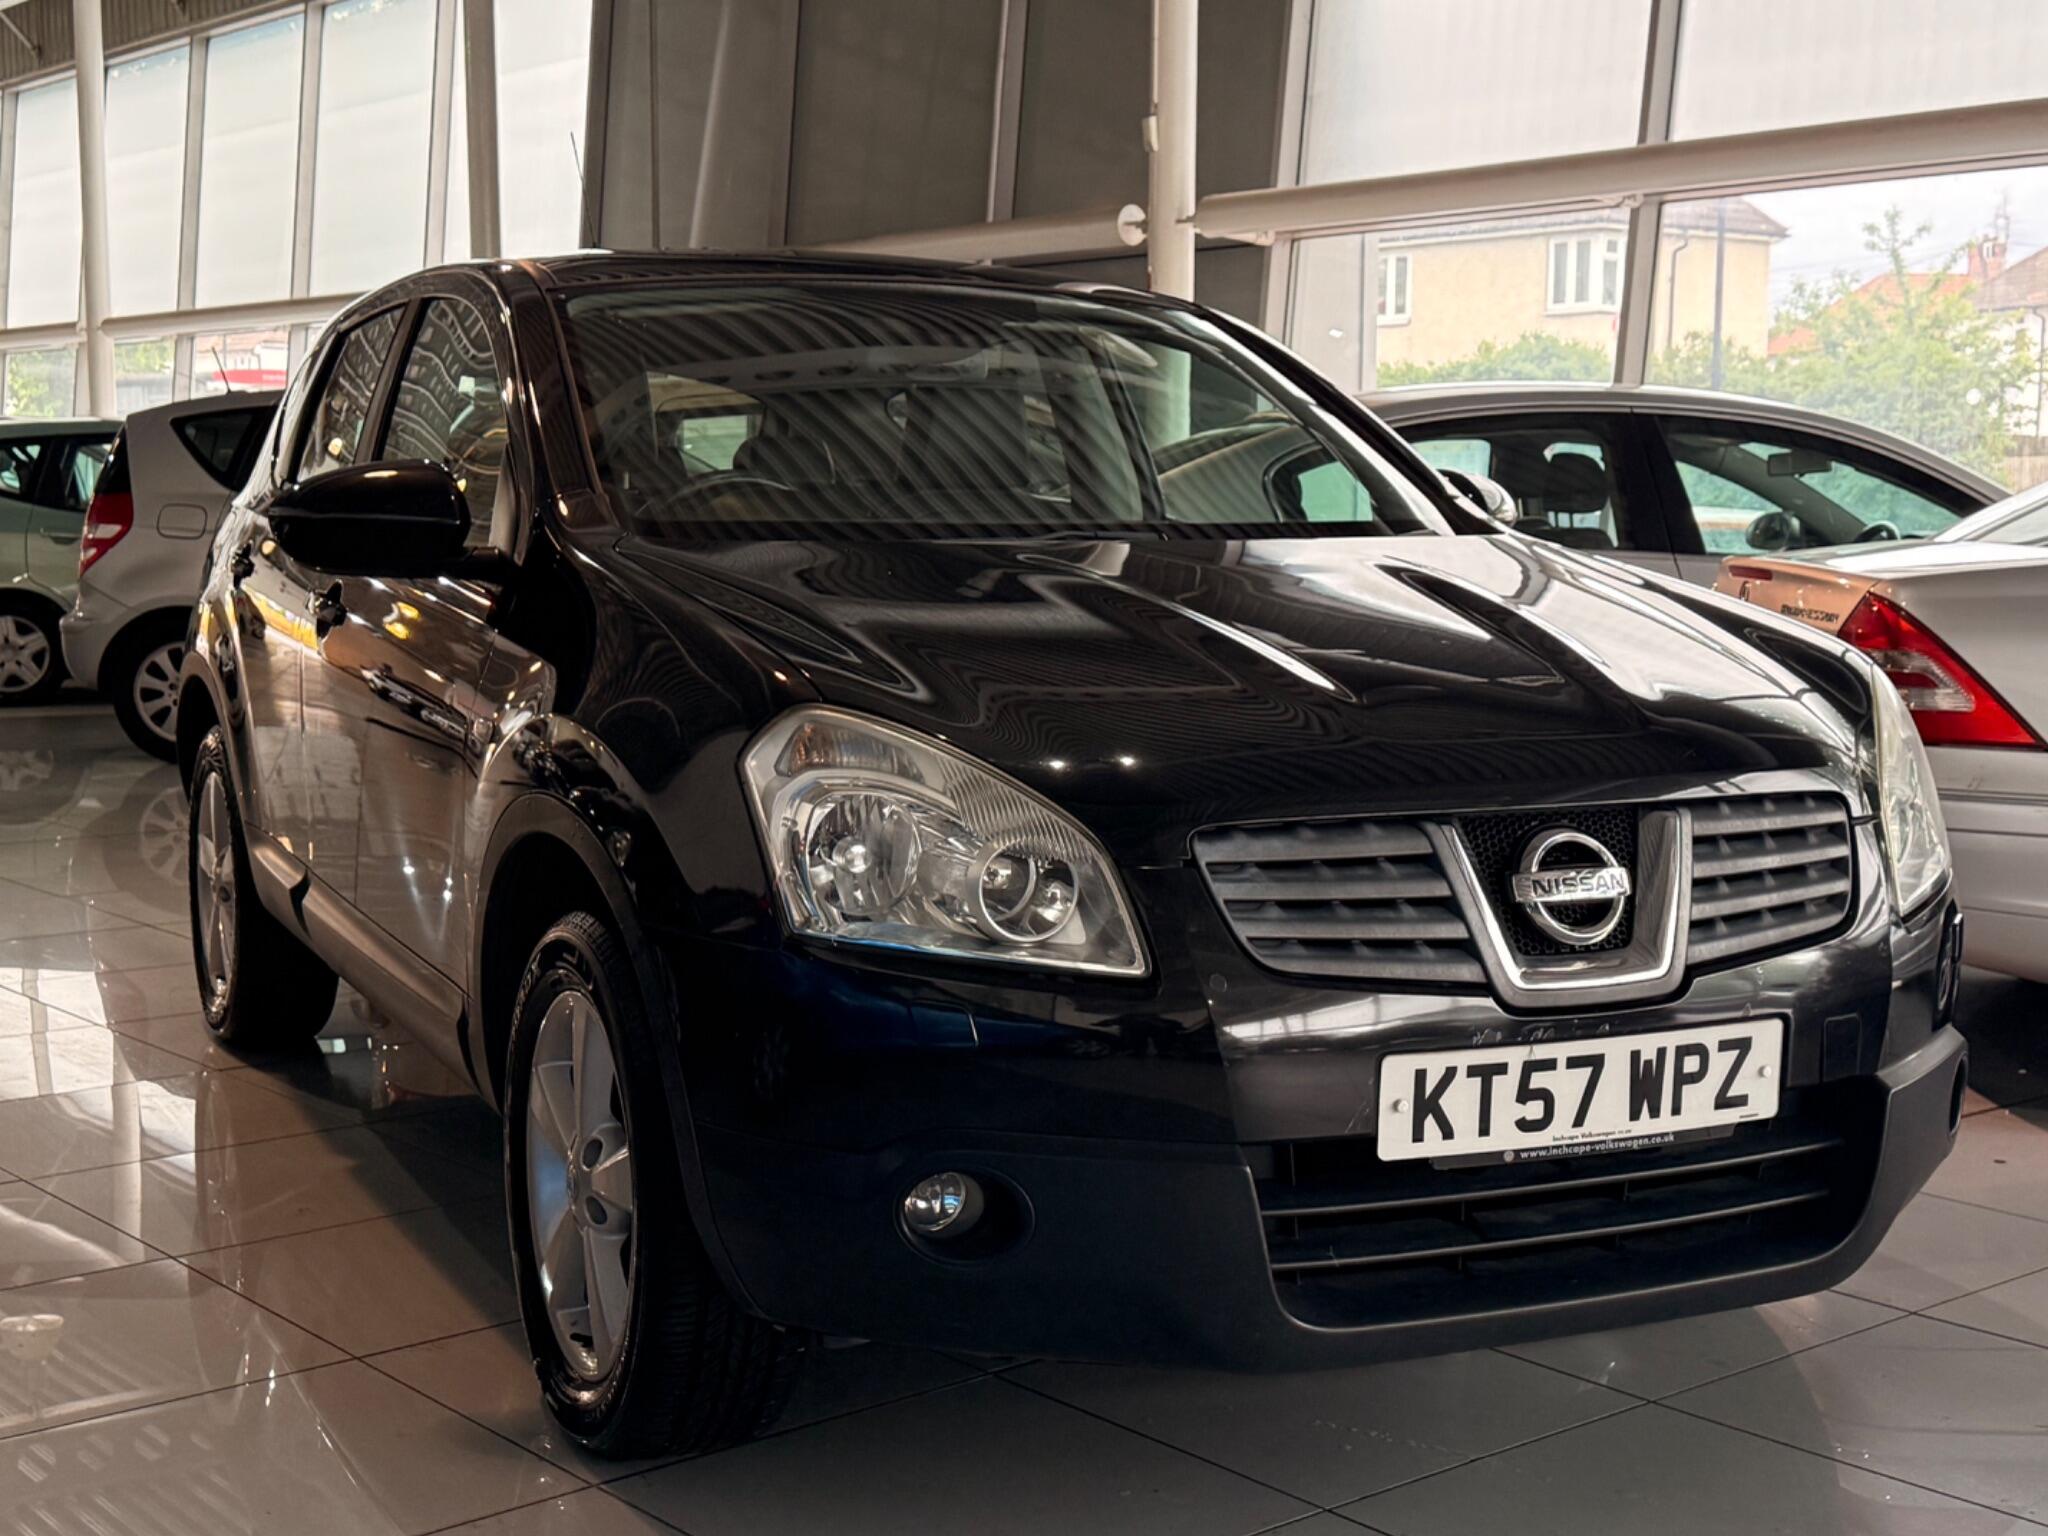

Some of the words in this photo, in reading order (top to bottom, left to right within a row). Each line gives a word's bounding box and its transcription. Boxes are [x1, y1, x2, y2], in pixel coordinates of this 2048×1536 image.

[1531, 872, 1626, 896] NISSAN
[1411, 1053, 1606, 1144] KT57
[1628, 1036, 1753, 1122] WPZ
[1519, 1133, 1675, 1160] www.inchcape-volkswagen.co.uk
